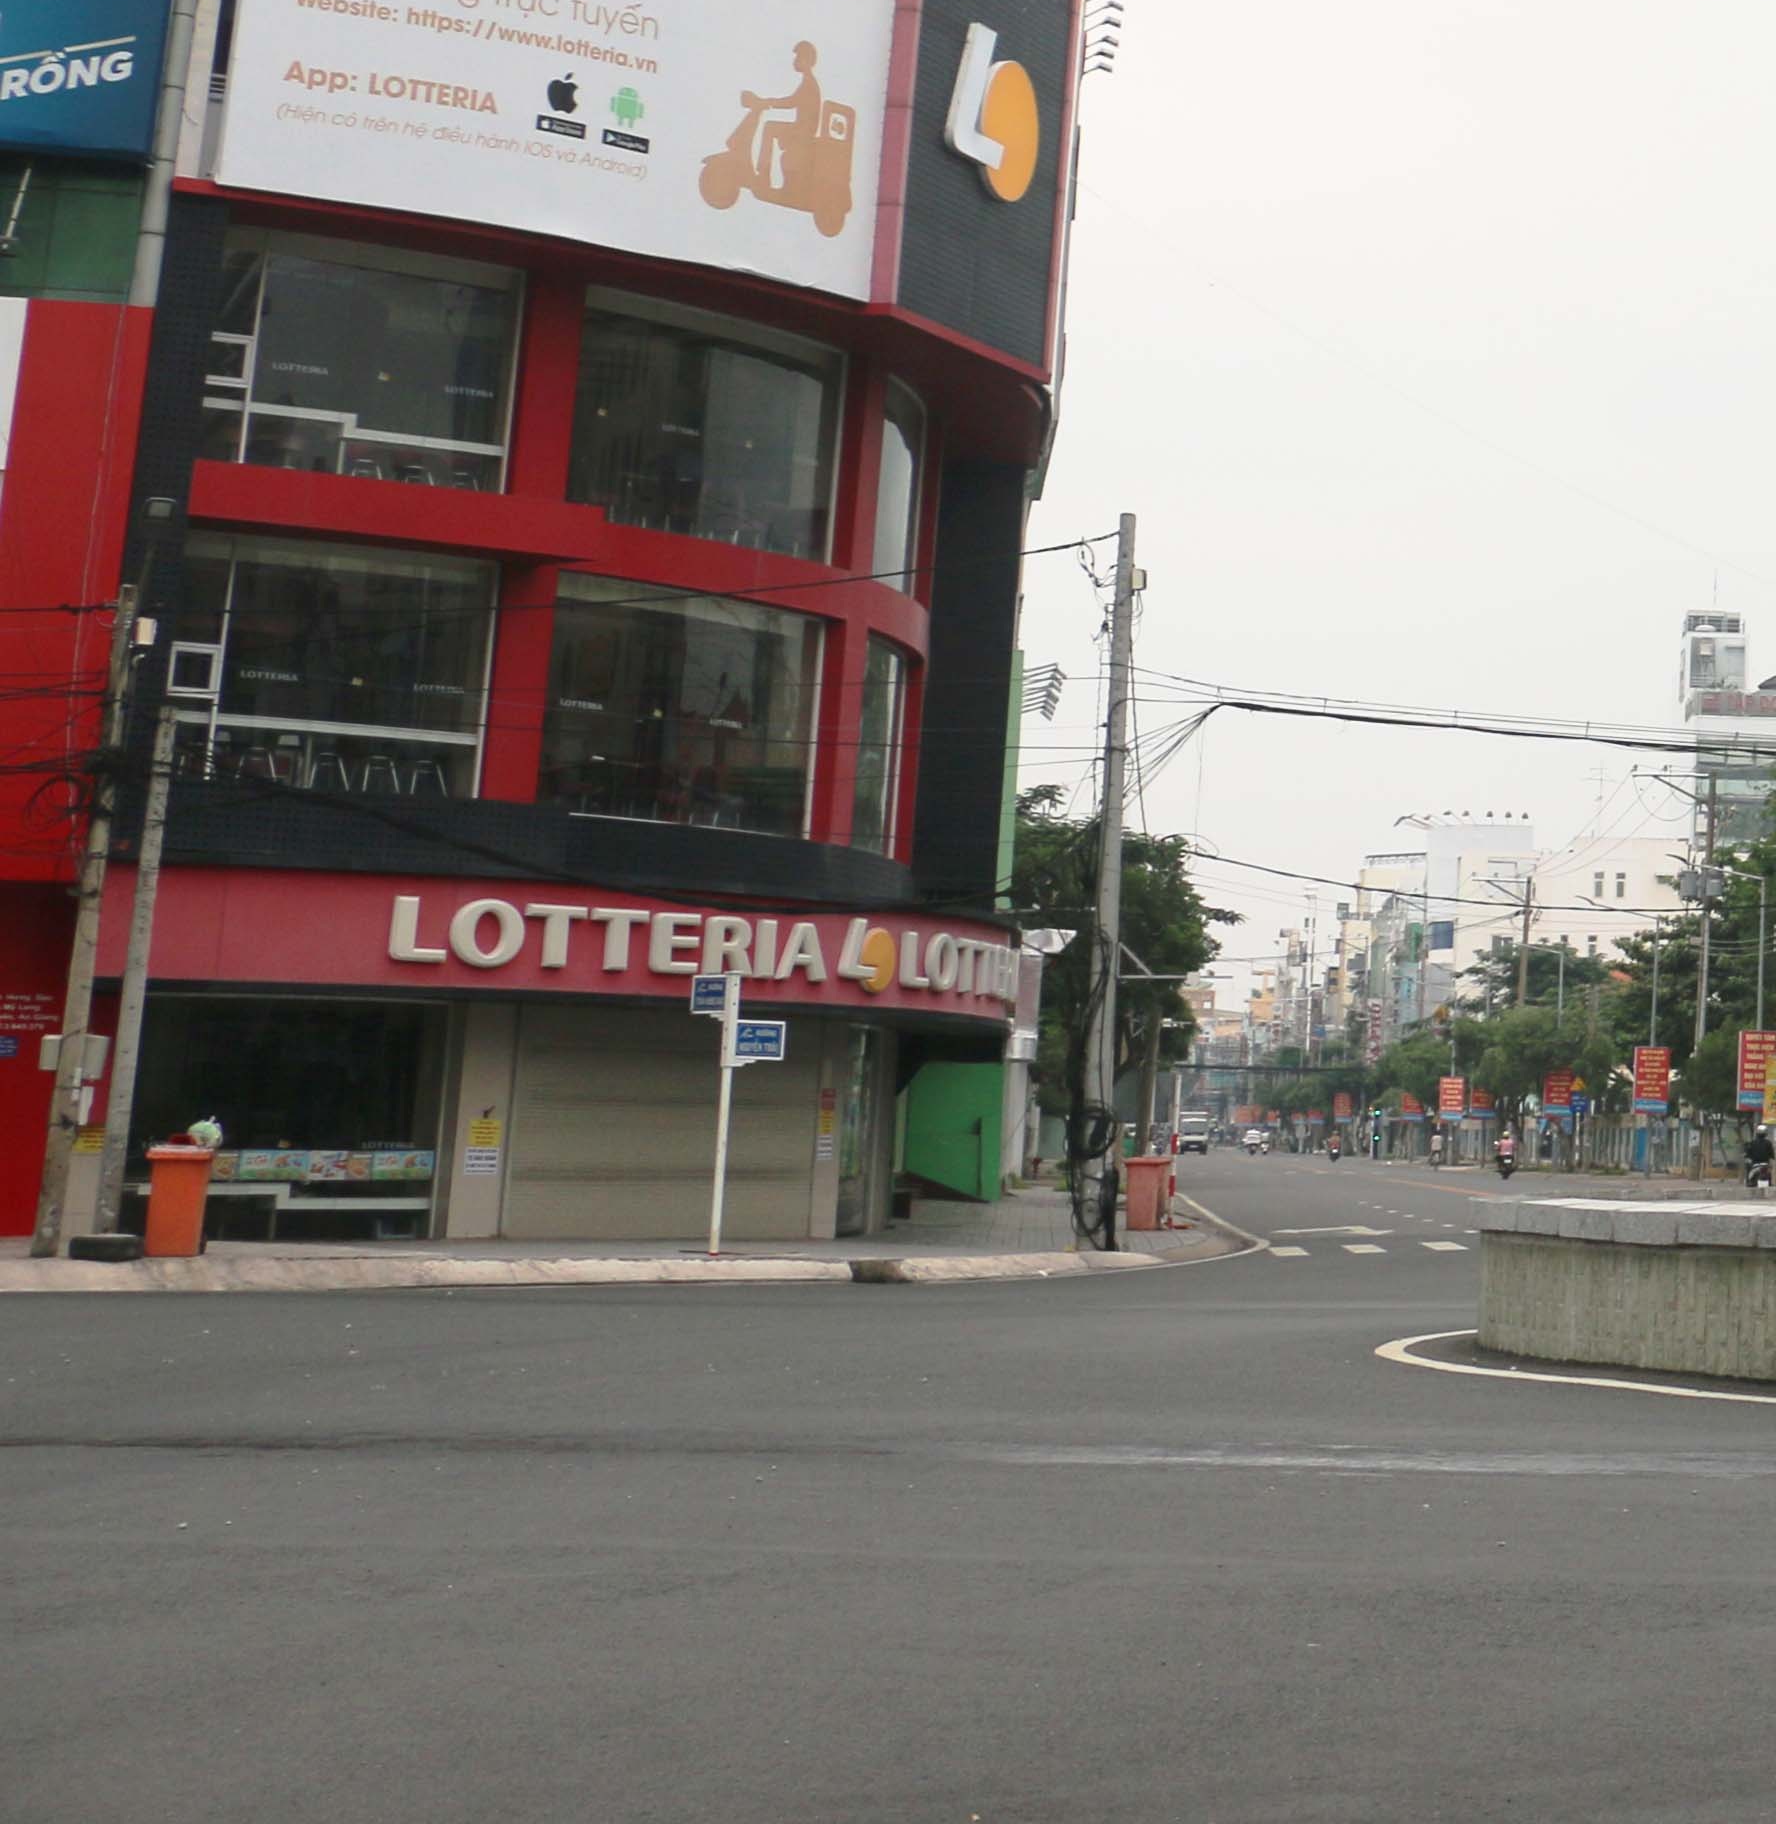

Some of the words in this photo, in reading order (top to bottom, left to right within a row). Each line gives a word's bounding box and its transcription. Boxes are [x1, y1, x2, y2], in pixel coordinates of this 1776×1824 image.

[406, 6, 659, 74] https://www.lotteria.vn
[0, 49, 134, 101] RỒNG
[284, 60, 358, 95] App:
[368, 72, 498, 115] LOTTERIA
[271, 361, 330, 376] LOTTERIA
[444, 384, 496, 400] LOTTERIA
[239, 669, 299, 683] LOTTERIA
[559, 696, 604, 712] LOTTERIA
[388, 895, 828, 983] LOTTERIA
